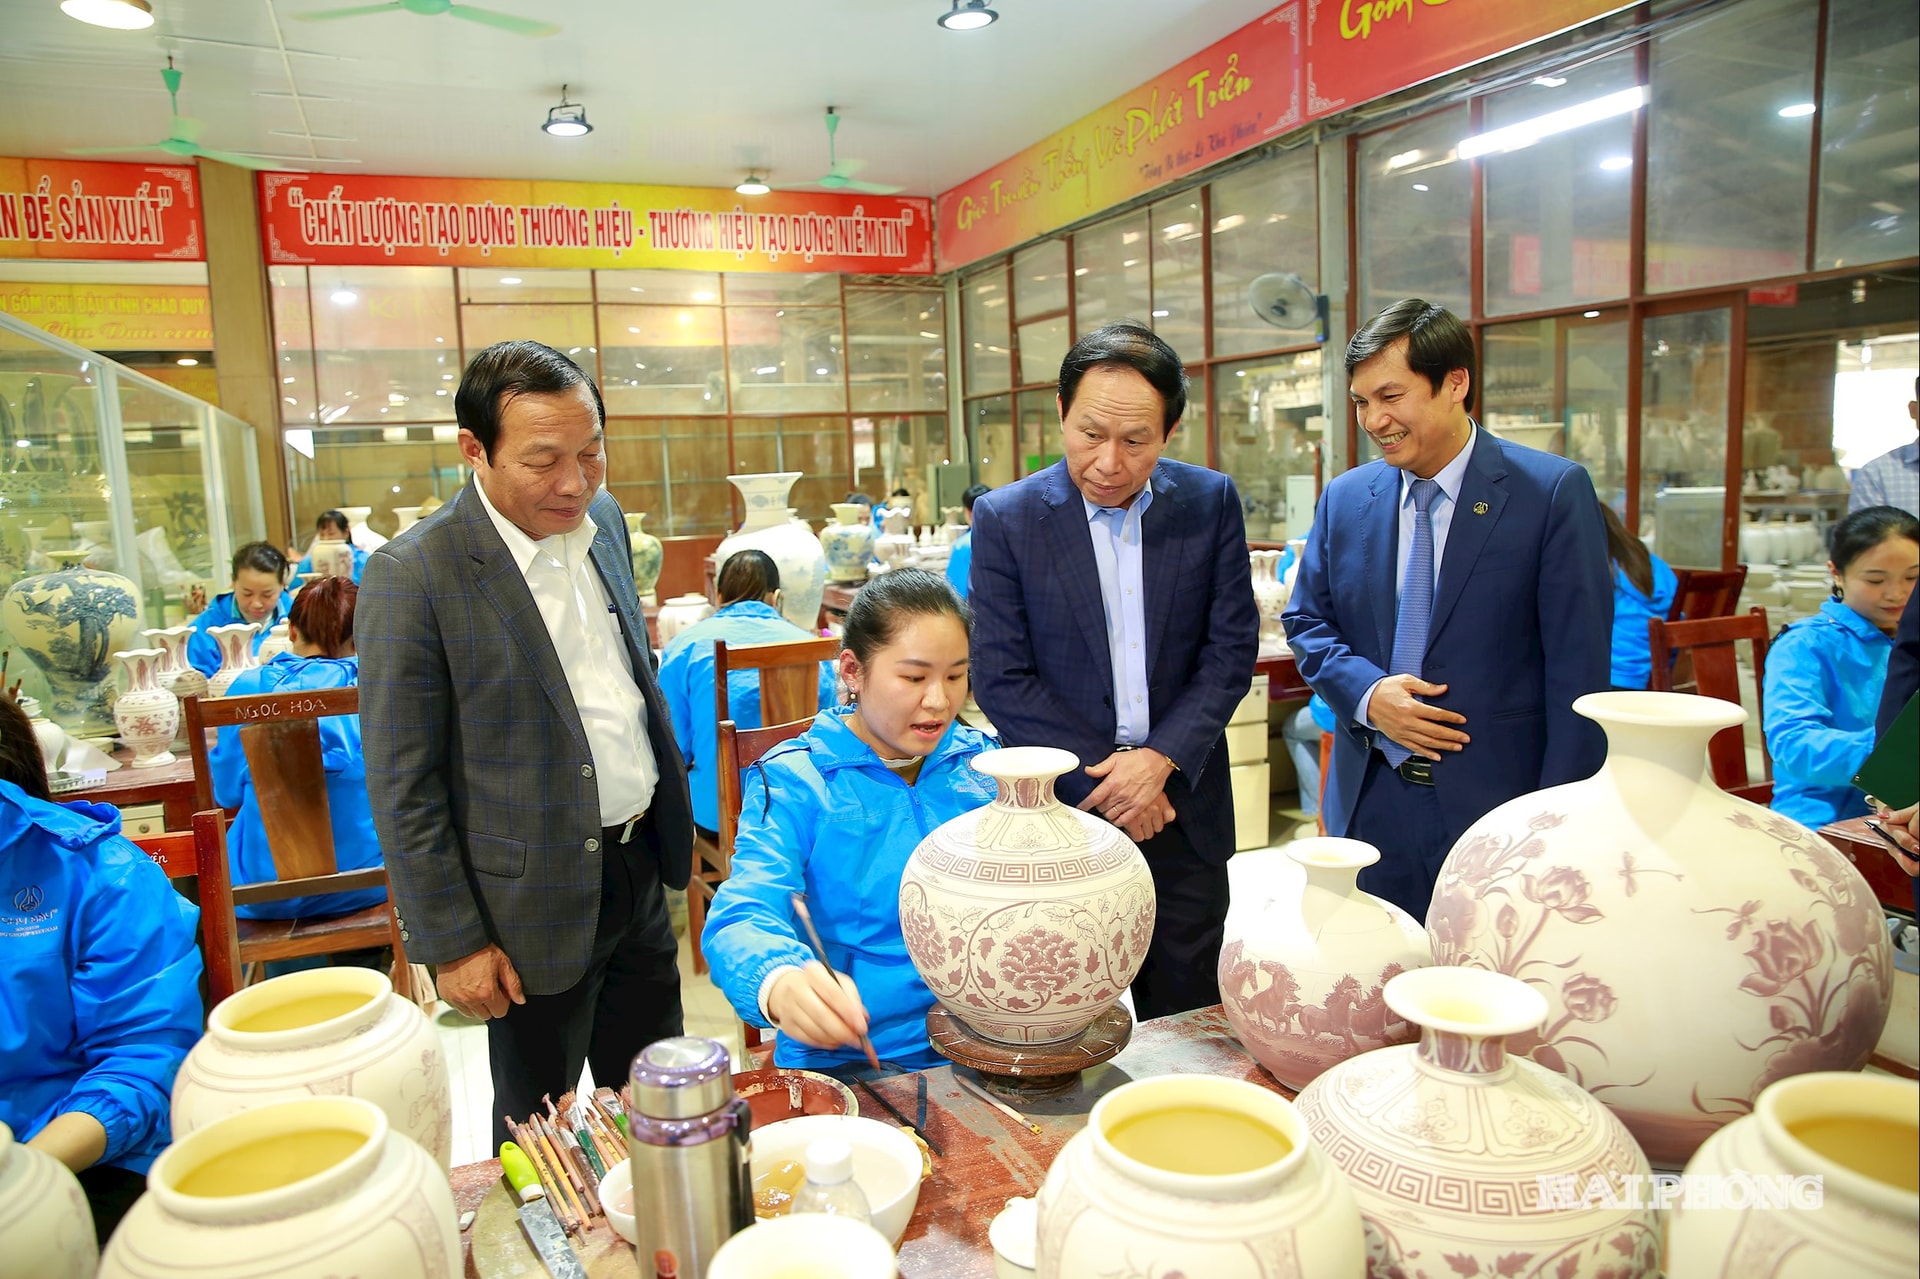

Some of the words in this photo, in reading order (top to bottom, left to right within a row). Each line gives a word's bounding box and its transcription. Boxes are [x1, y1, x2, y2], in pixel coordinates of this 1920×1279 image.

[1124, 88, 1183, 156] Phát
[1187, 53, 1253, 119] Triển
[22, 175, 56, 242] ĐỂ
[58, 180, 107, 244] SẢN
[356, 197, 423, 256] LƯỢNG
[424, 203, 462, 256] TẠO
[464, 200, 516, 256] DỰNG
[518, 204, 590, 250] THƯƠNG
[593, 200, 633, 258] HIỆU
[647, 206, 716, 251] THƯƠNG
[717, 205, 757, 261] HIỆU
[757, 213, 789, 262] TẠO
[790, 211, 836, 263] DỰNG
[289, 698, 327, 713] HOA
